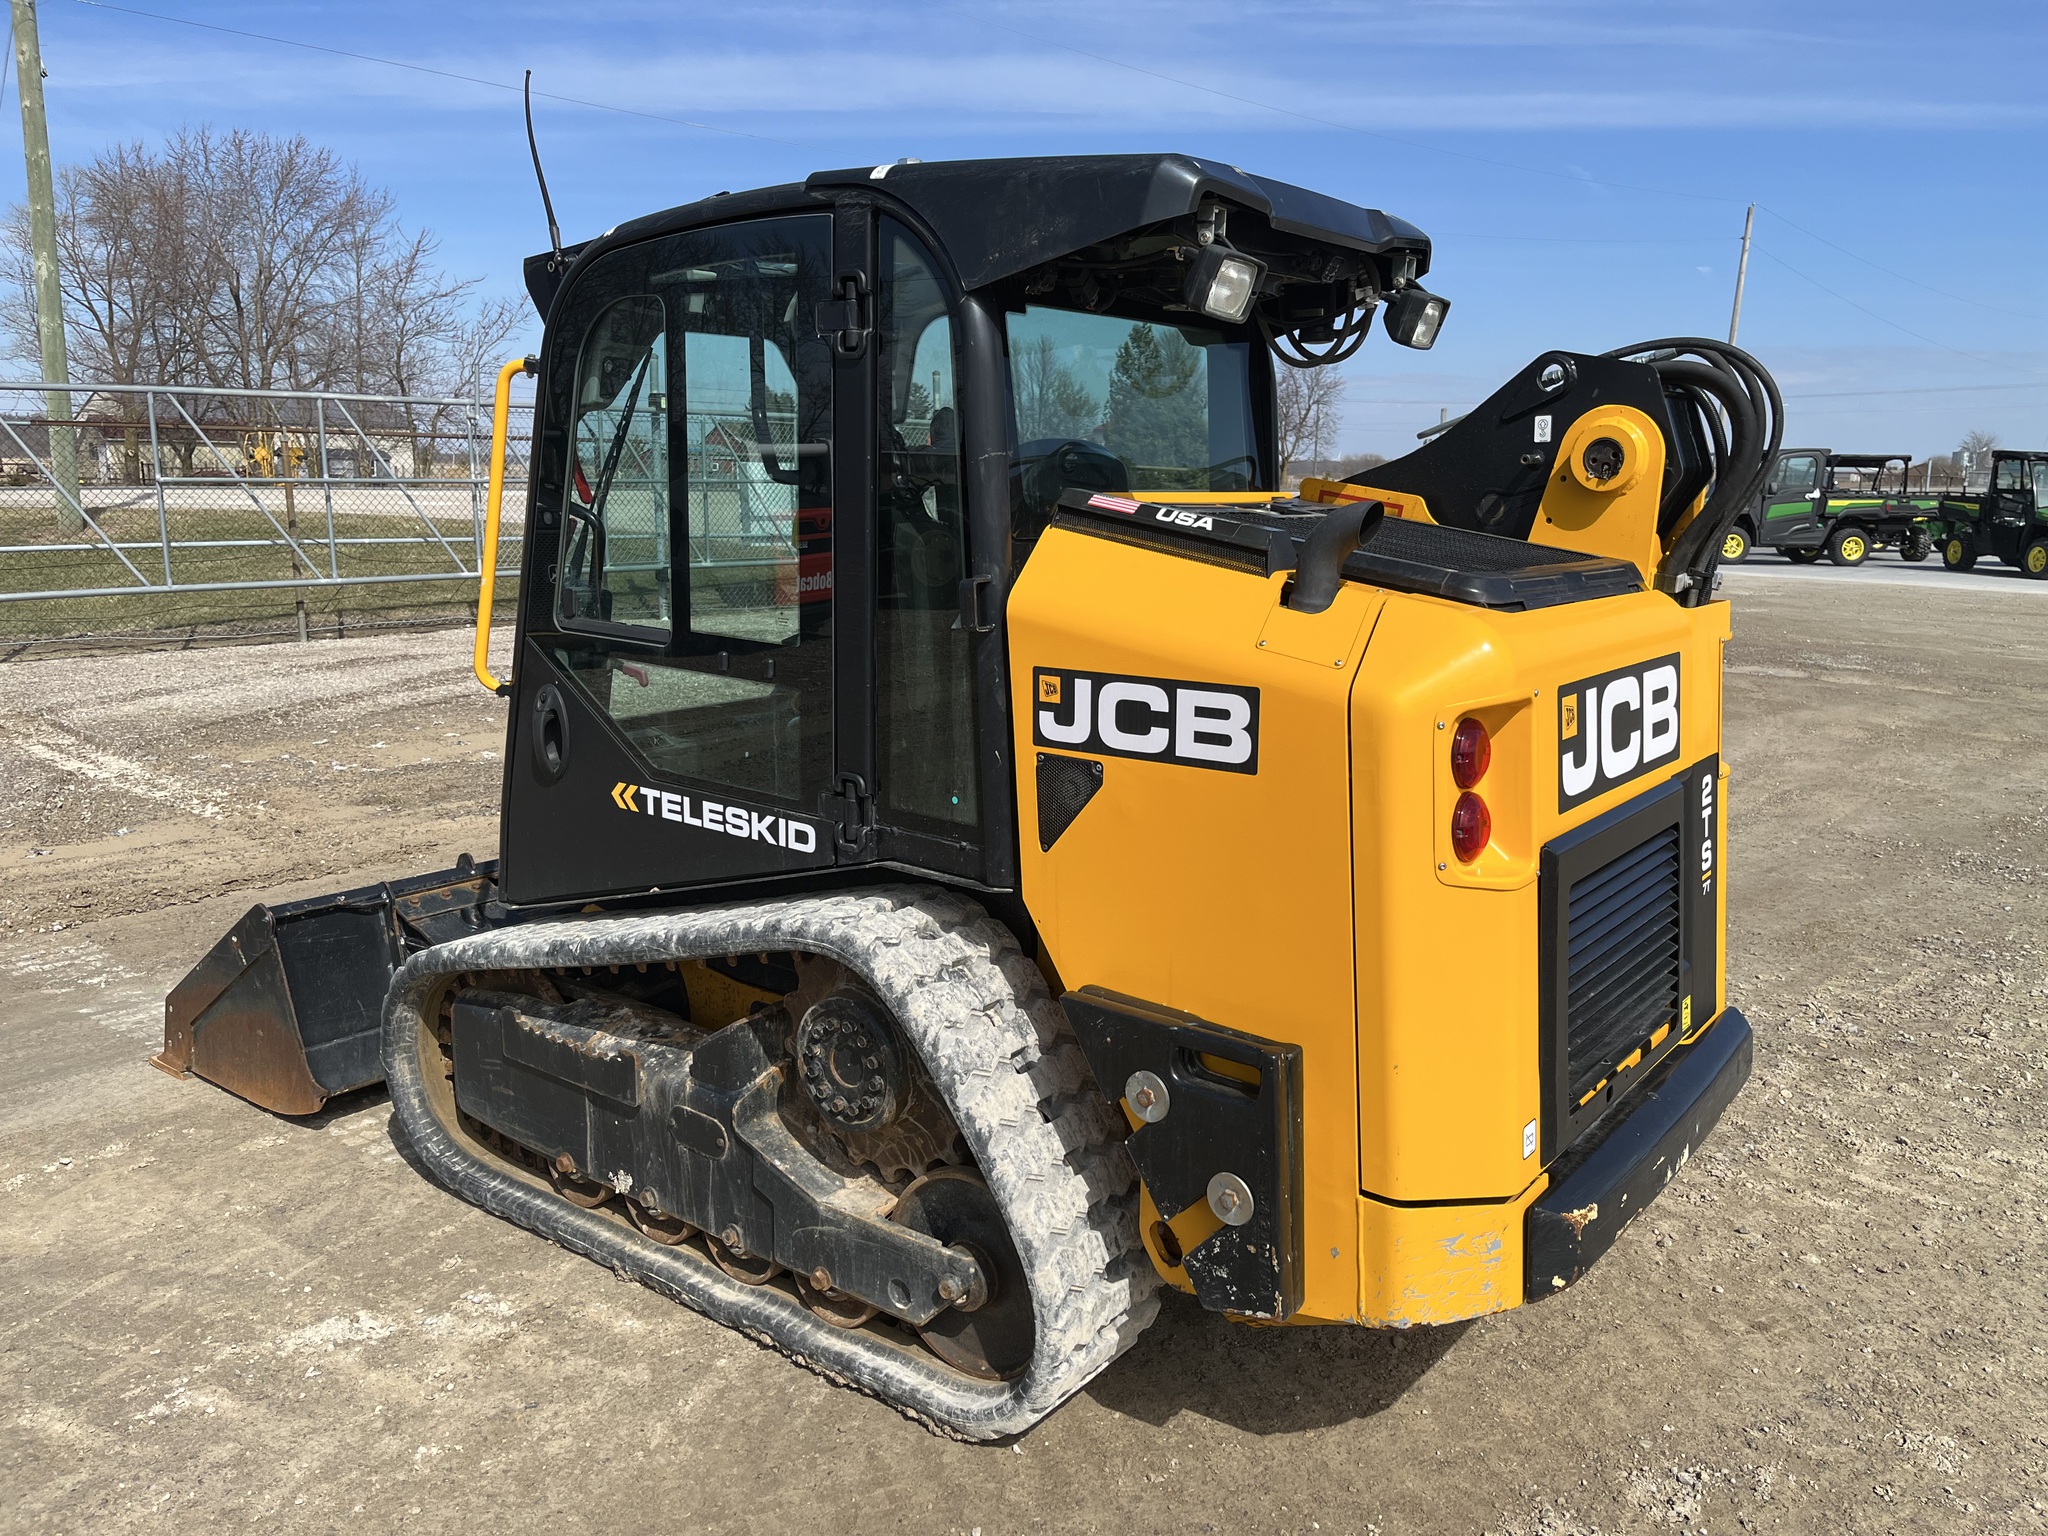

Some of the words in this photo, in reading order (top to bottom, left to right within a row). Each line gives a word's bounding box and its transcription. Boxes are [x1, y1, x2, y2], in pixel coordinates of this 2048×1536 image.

[1155, 508, 1213, 531] USA
[1039, 678, 1252, 764] JCB
[1562, 665, 1678, 797] JCB
[639, 786, 816, 854] TELESKID
